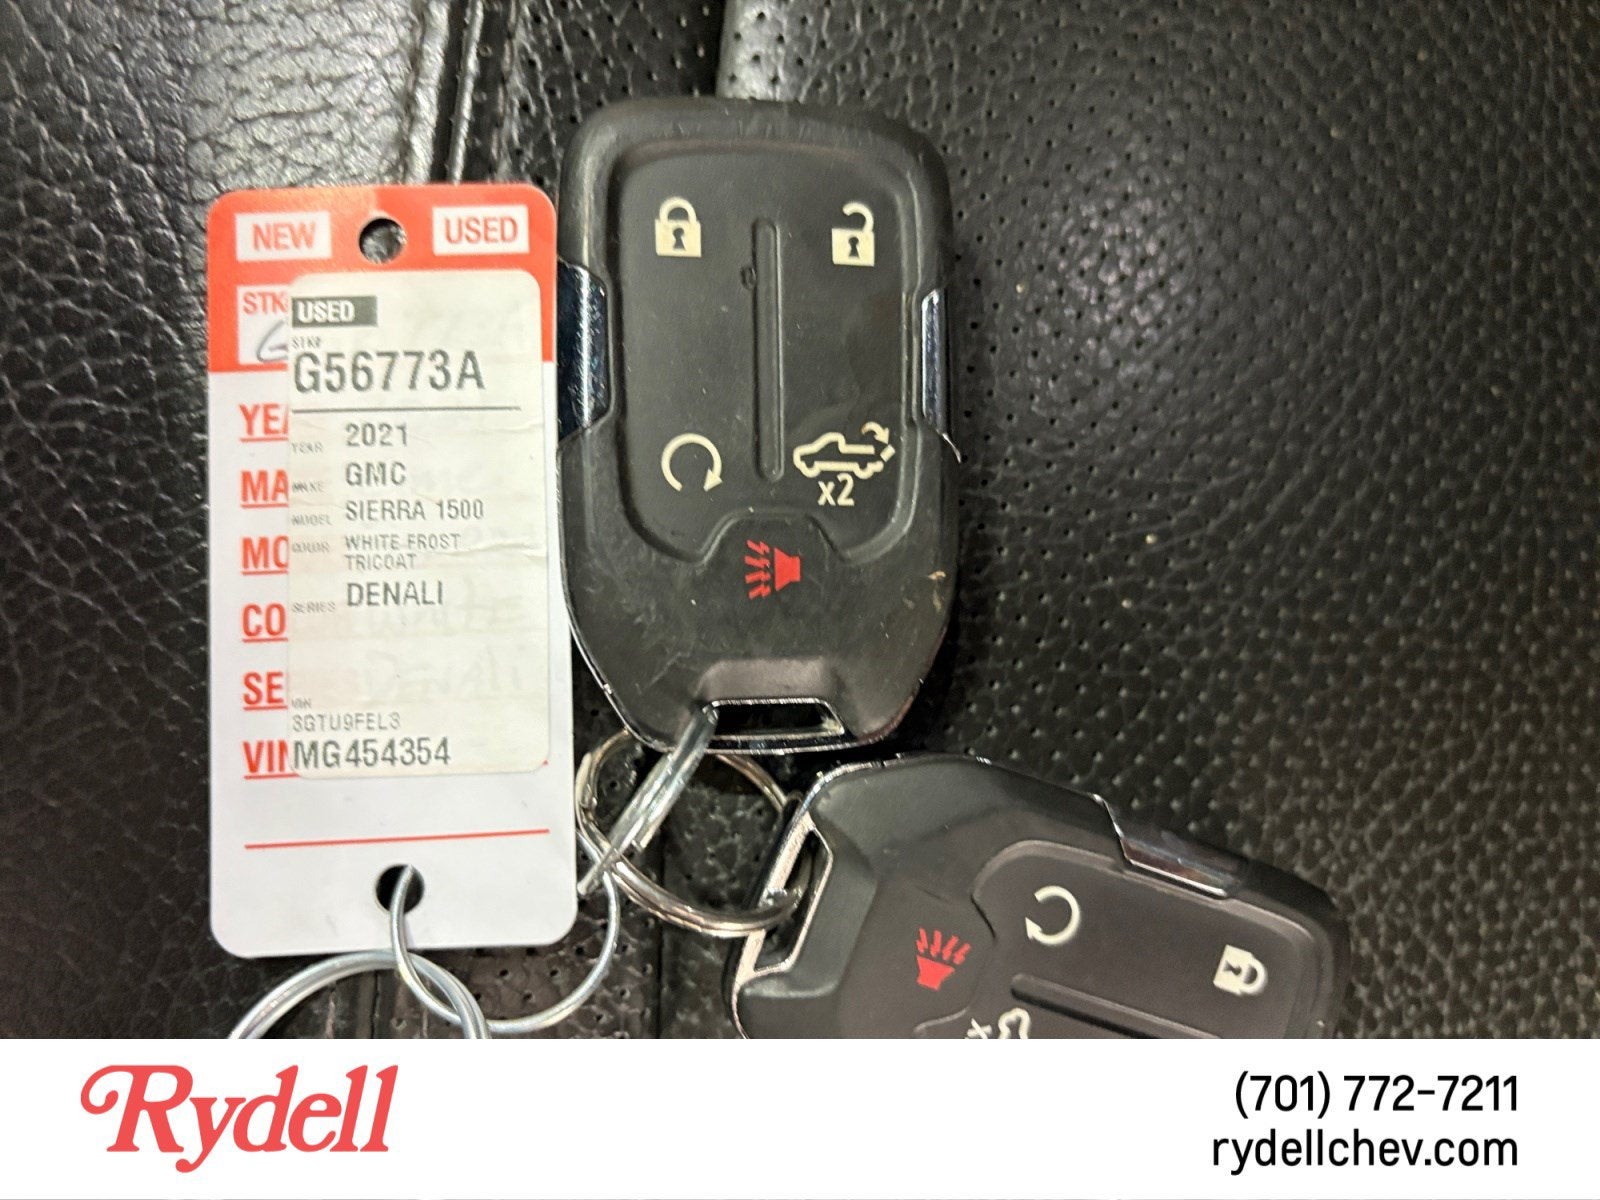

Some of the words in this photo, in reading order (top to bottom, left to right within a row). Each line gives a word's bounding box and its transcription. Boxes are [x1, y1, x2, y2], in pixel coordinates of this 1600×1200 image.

[252, 222, 317, 250] NEW
[444, 216, 519, 245] USED
[298, 300, 356, 323] USED
[294, 350, 486, 394] G56773A
[345, 422, 408, 448] 2021
[345, 461, 407, 487] GMC
[817, 473, 855, 506] x2
[345, 499, 426, 521] SIERRA
[436, 498, 485, 520] 1500
[344, 533, 399, 551] WHITE
[406, 533, 462, 551] FROST
[345, 553, 418, 571] TRICOAT
[346, 581, 444, 608] DENALI
[292, 737, 451, 770] MG454354
